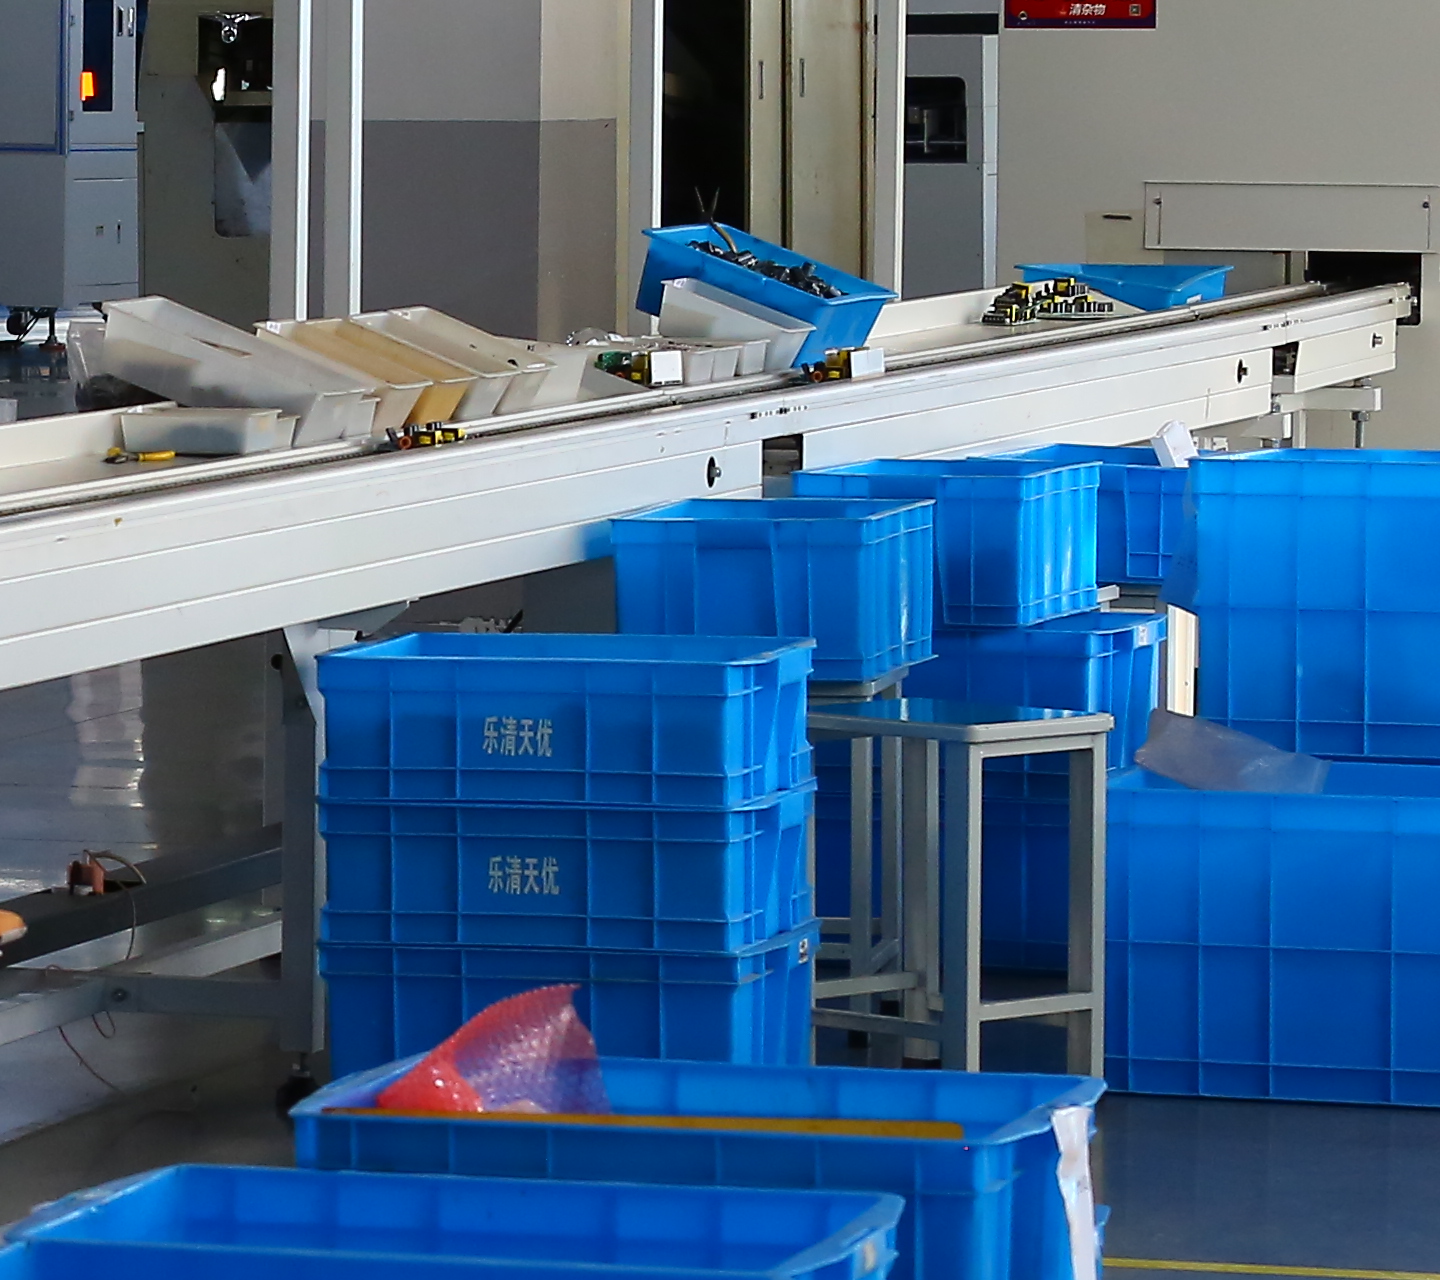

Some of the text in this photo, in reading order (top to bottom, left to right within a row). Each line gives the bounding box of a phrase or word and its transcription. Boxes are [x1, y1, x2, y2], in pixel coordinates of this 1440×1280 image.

[483, 717, 553, 757] 乐清天优
[489, 855, 560, 895] 乐清天优
